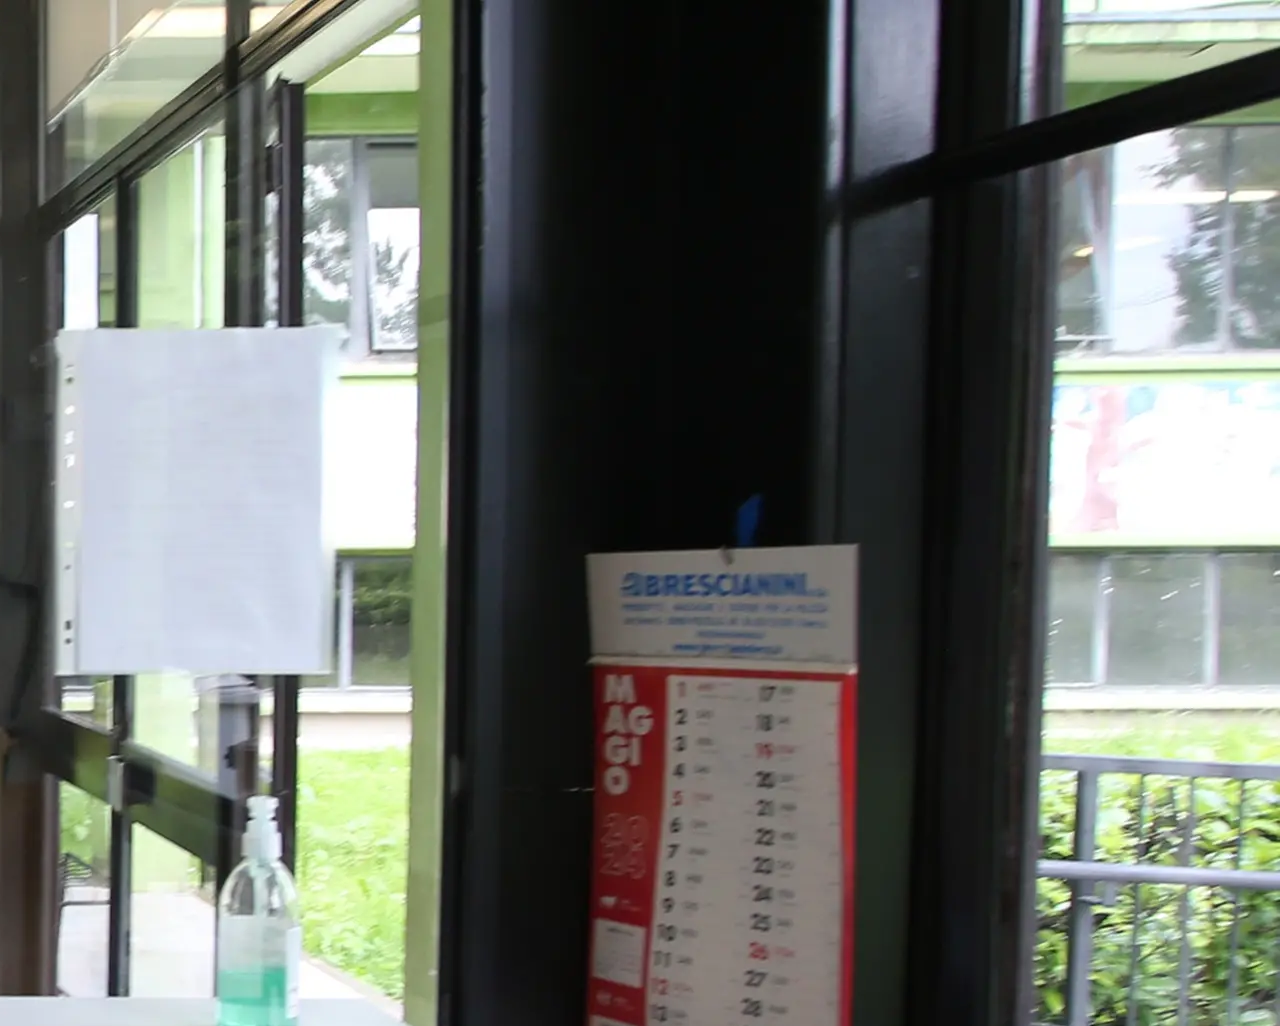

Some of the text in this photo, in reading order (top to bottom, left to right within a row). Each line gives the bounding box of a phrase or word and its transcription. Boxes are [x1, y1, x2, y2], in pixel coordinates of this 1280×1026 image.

[677, 682, 686, 698] 1
[758, 685, 777, 702] 17
[675, 708, 687, 725] 2
[674, 736, 687, 752] 3
[672, 763, 685, 778] 4
[754, 770, 776, 789] 20
[672, 790, 683, 806] 5
[755, 799, 774, 817] 21
[669, 817, 683, 833] 6
[754, 828, 775, 846] 22
[667, 843, 681, 859] 7
[753, 856, 774, 875] 23
[664, 870, 677, 887] 8
[752, 884, 774, 902] 24
[662, 897, 675, 913] 9
[750, 913, 772, 932] 25
[657, 923, 677, 941] 10
[653, 950, 672, 968] 11
[749, 941, 769, 961] 26
[651, 977, 669, 995] 12
[744, 969, 769, 988] 27
[741, 997, 763, 1017] 28
